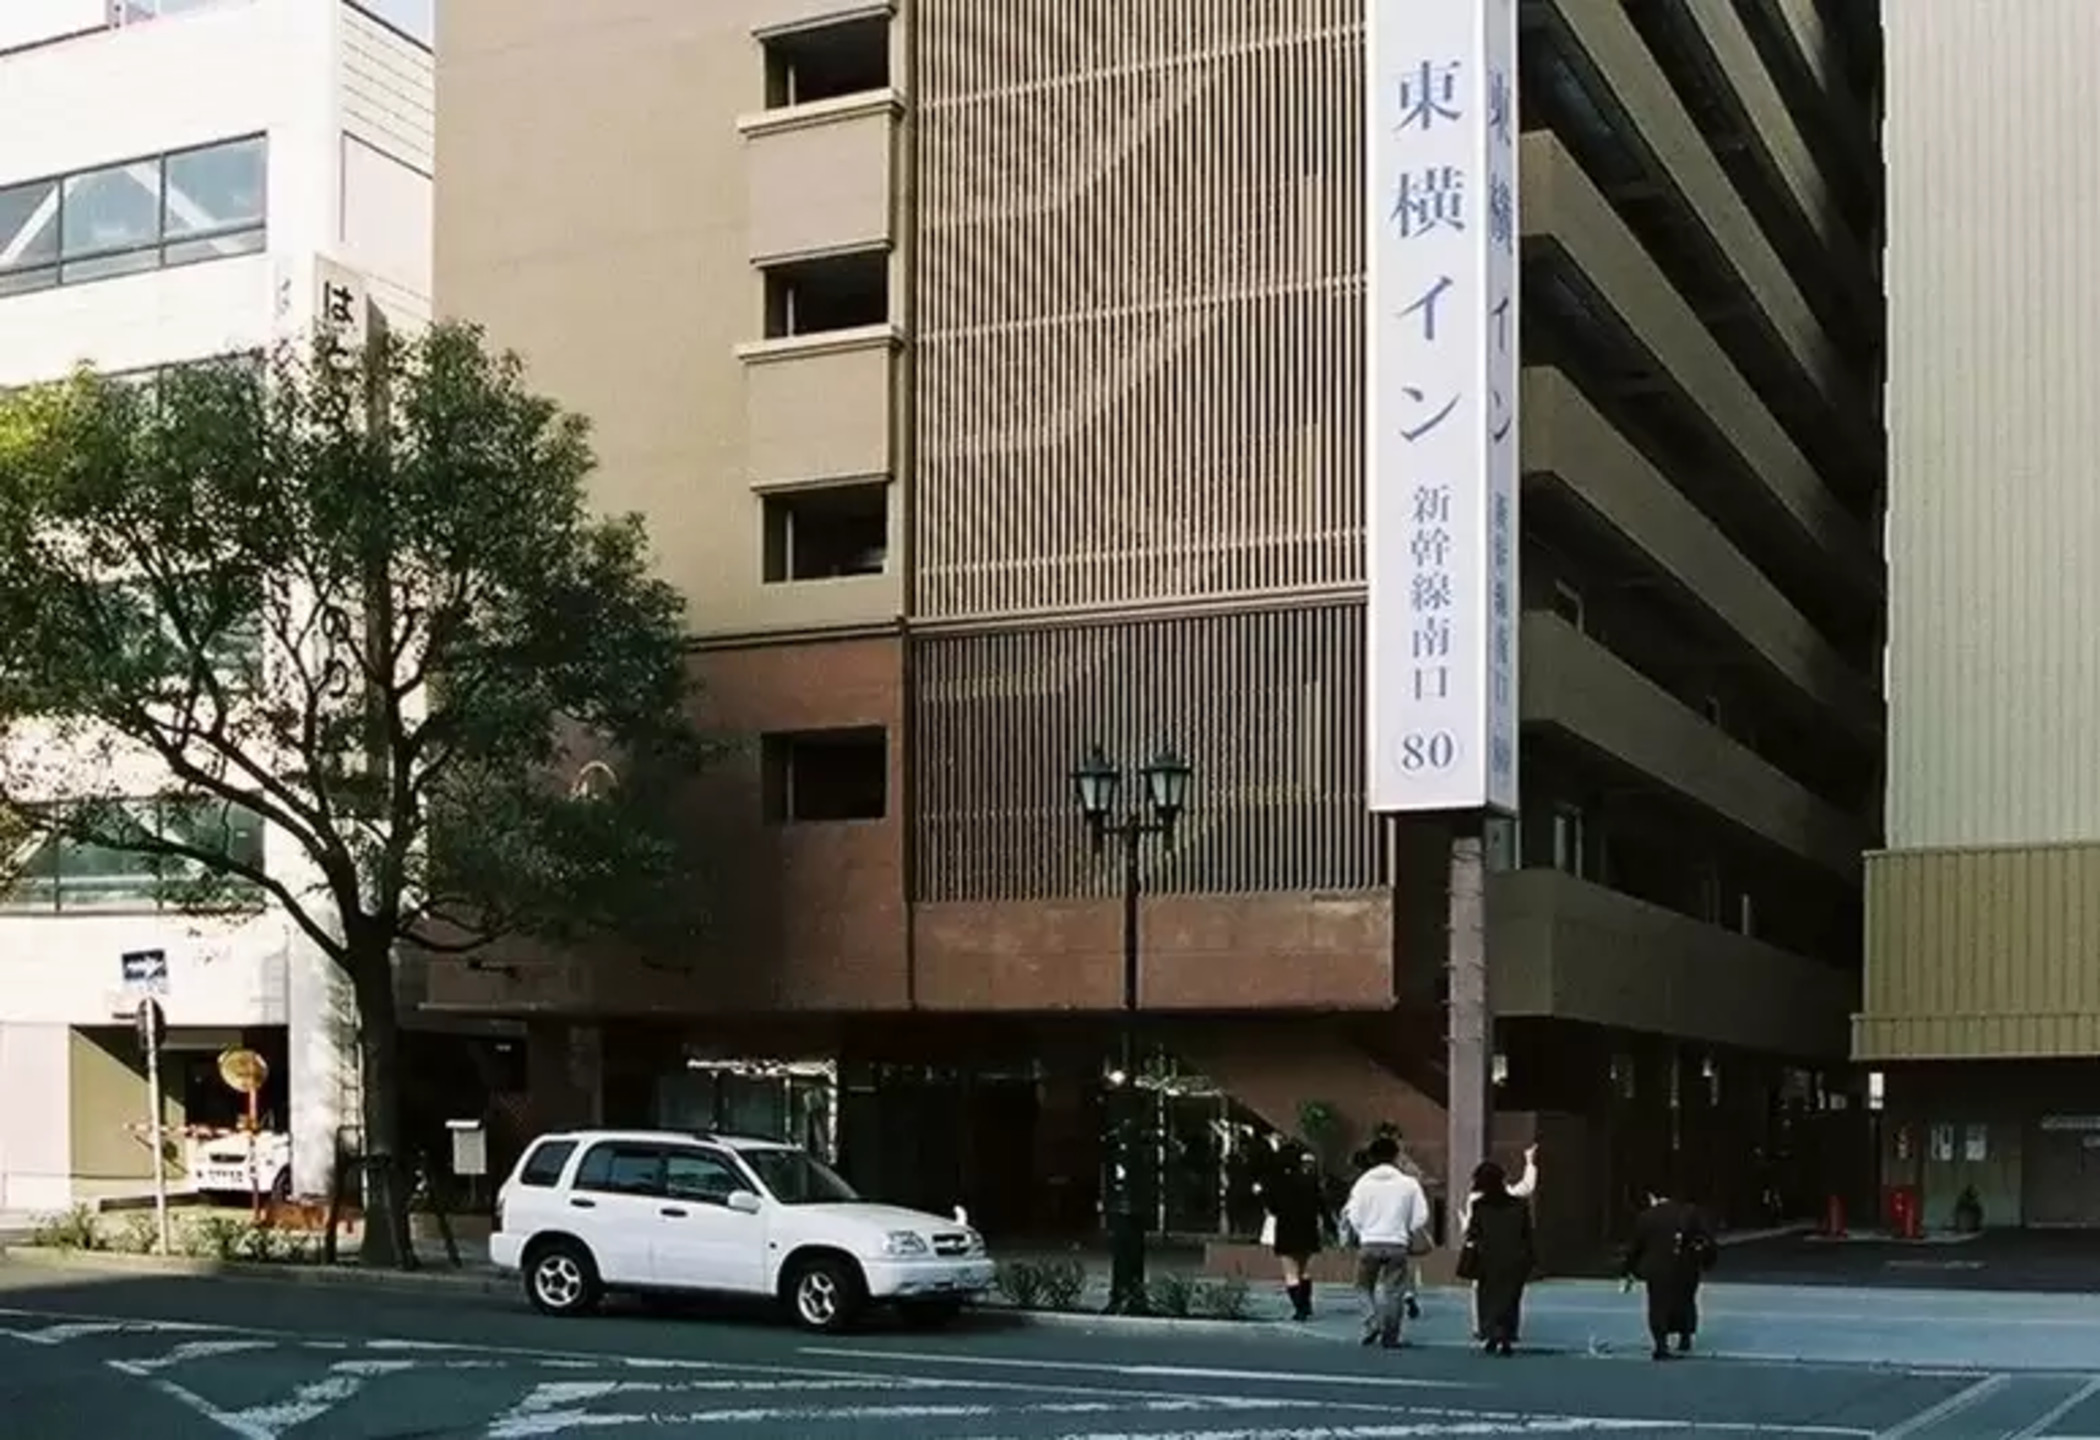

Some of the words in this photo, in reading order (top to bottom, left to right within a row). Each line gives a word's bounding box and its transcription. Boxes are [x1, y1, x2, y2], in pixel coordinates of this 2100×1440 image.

[1390, 60, 1465, 443] 東横イン
[1410, 484, 1451, 701] 新幹線南口
[1401, 732, 1454, 771] 80
